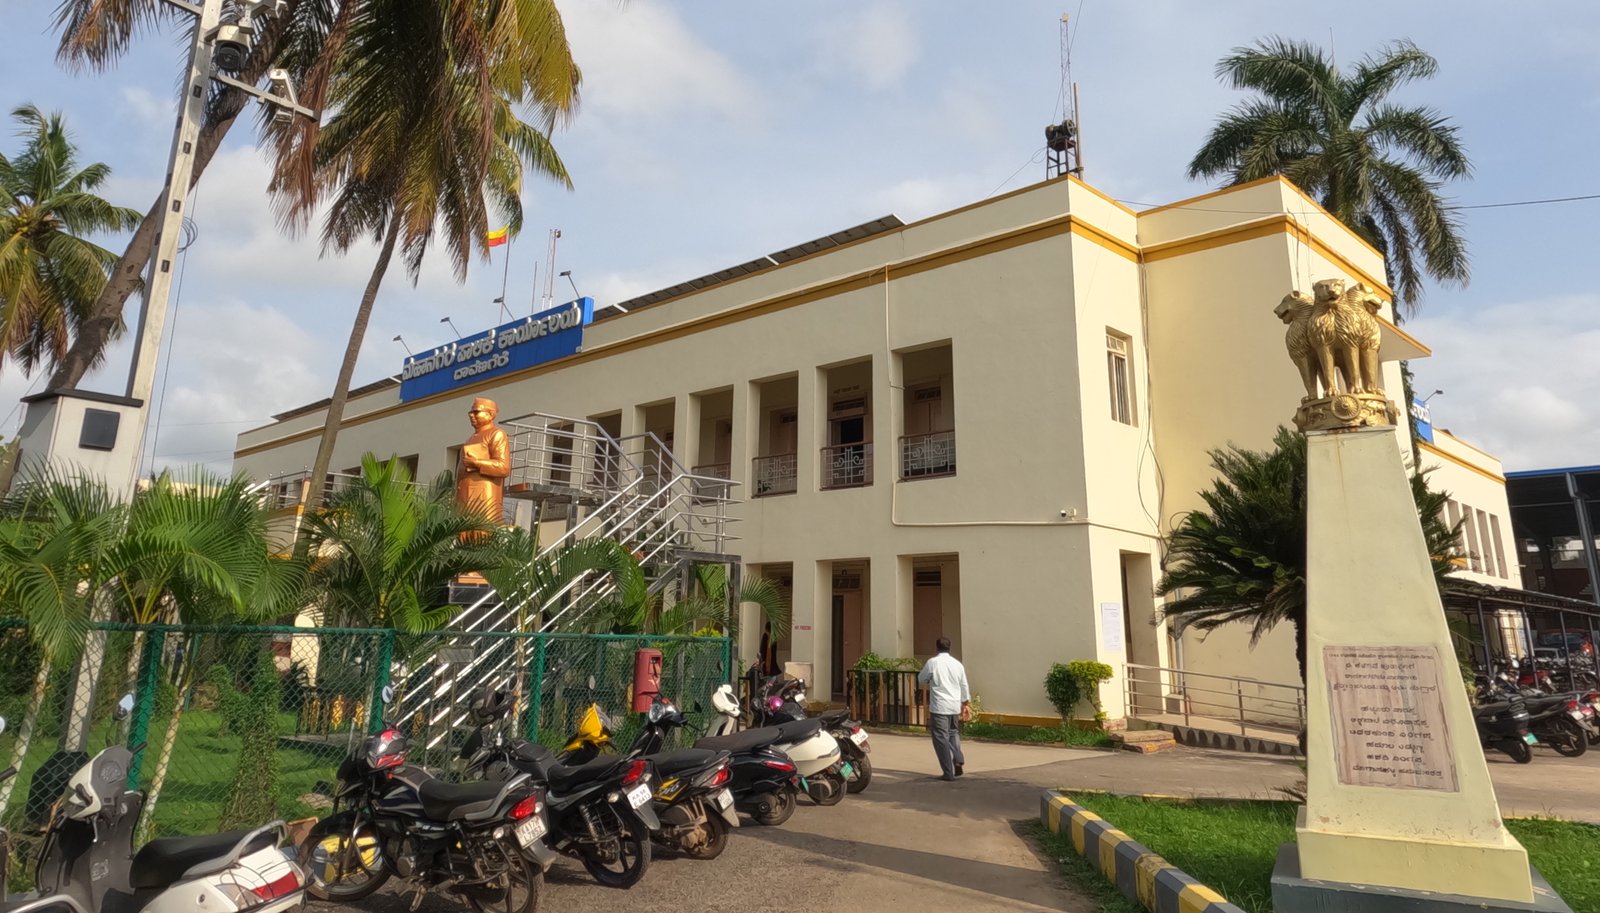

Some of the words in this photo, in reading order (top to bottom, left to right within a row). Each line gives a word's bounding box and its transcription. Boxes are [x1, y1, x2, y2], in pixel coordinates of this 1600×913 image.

[402, 342, 457, 380] ಮಹಾನಗರ
[457, 328, 496, 363] ಪಾಲಿಕೆ
[454, 351, 509, 380] ದಾವಣಗೆರೆ
